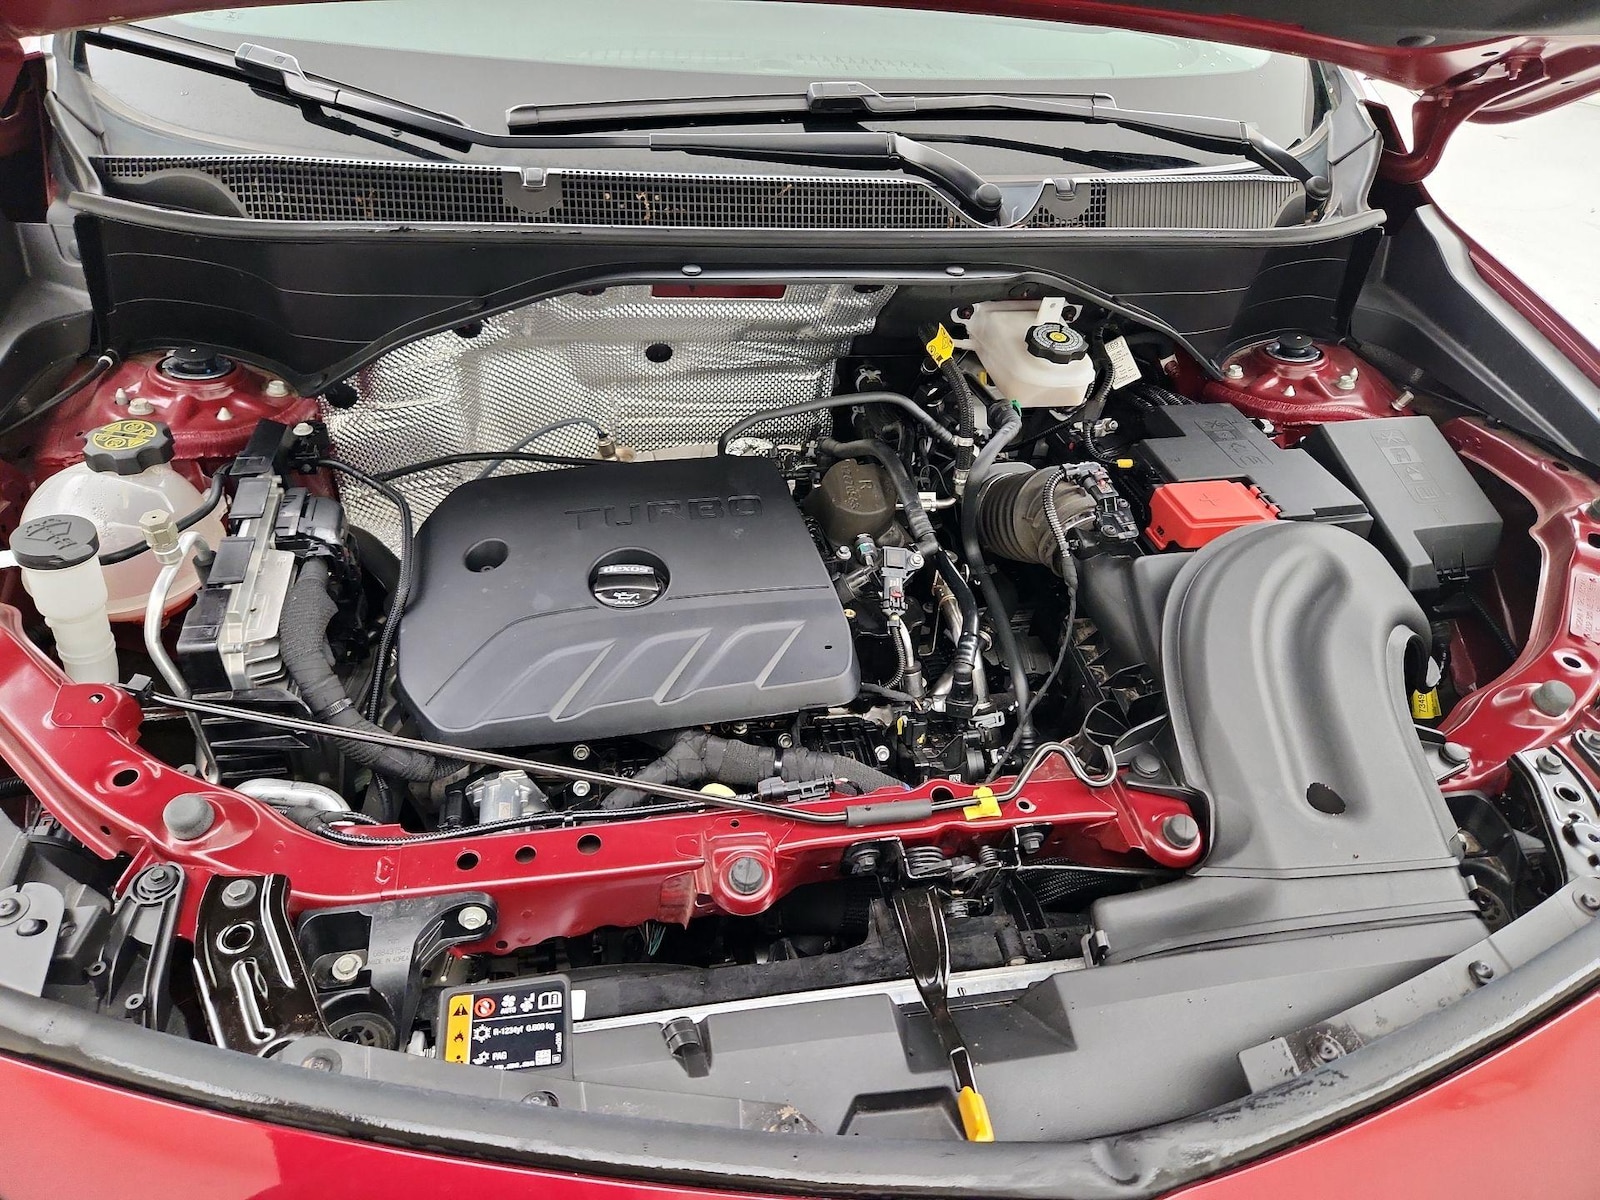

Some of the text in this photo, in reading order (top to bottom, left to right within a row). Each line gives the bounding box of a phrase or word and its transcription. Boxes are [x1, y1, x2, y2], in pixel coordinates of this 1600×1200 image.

[564, 494, 763, 530] TURBO
[603, 565, 649, 573] dexos
[1418, 694, 1426, 713] 7349
[500, 1006, 516, 1014] AUTO
[545, 1022, 555, 1031] kg
[492, 1051, 507, 1060] PAG
